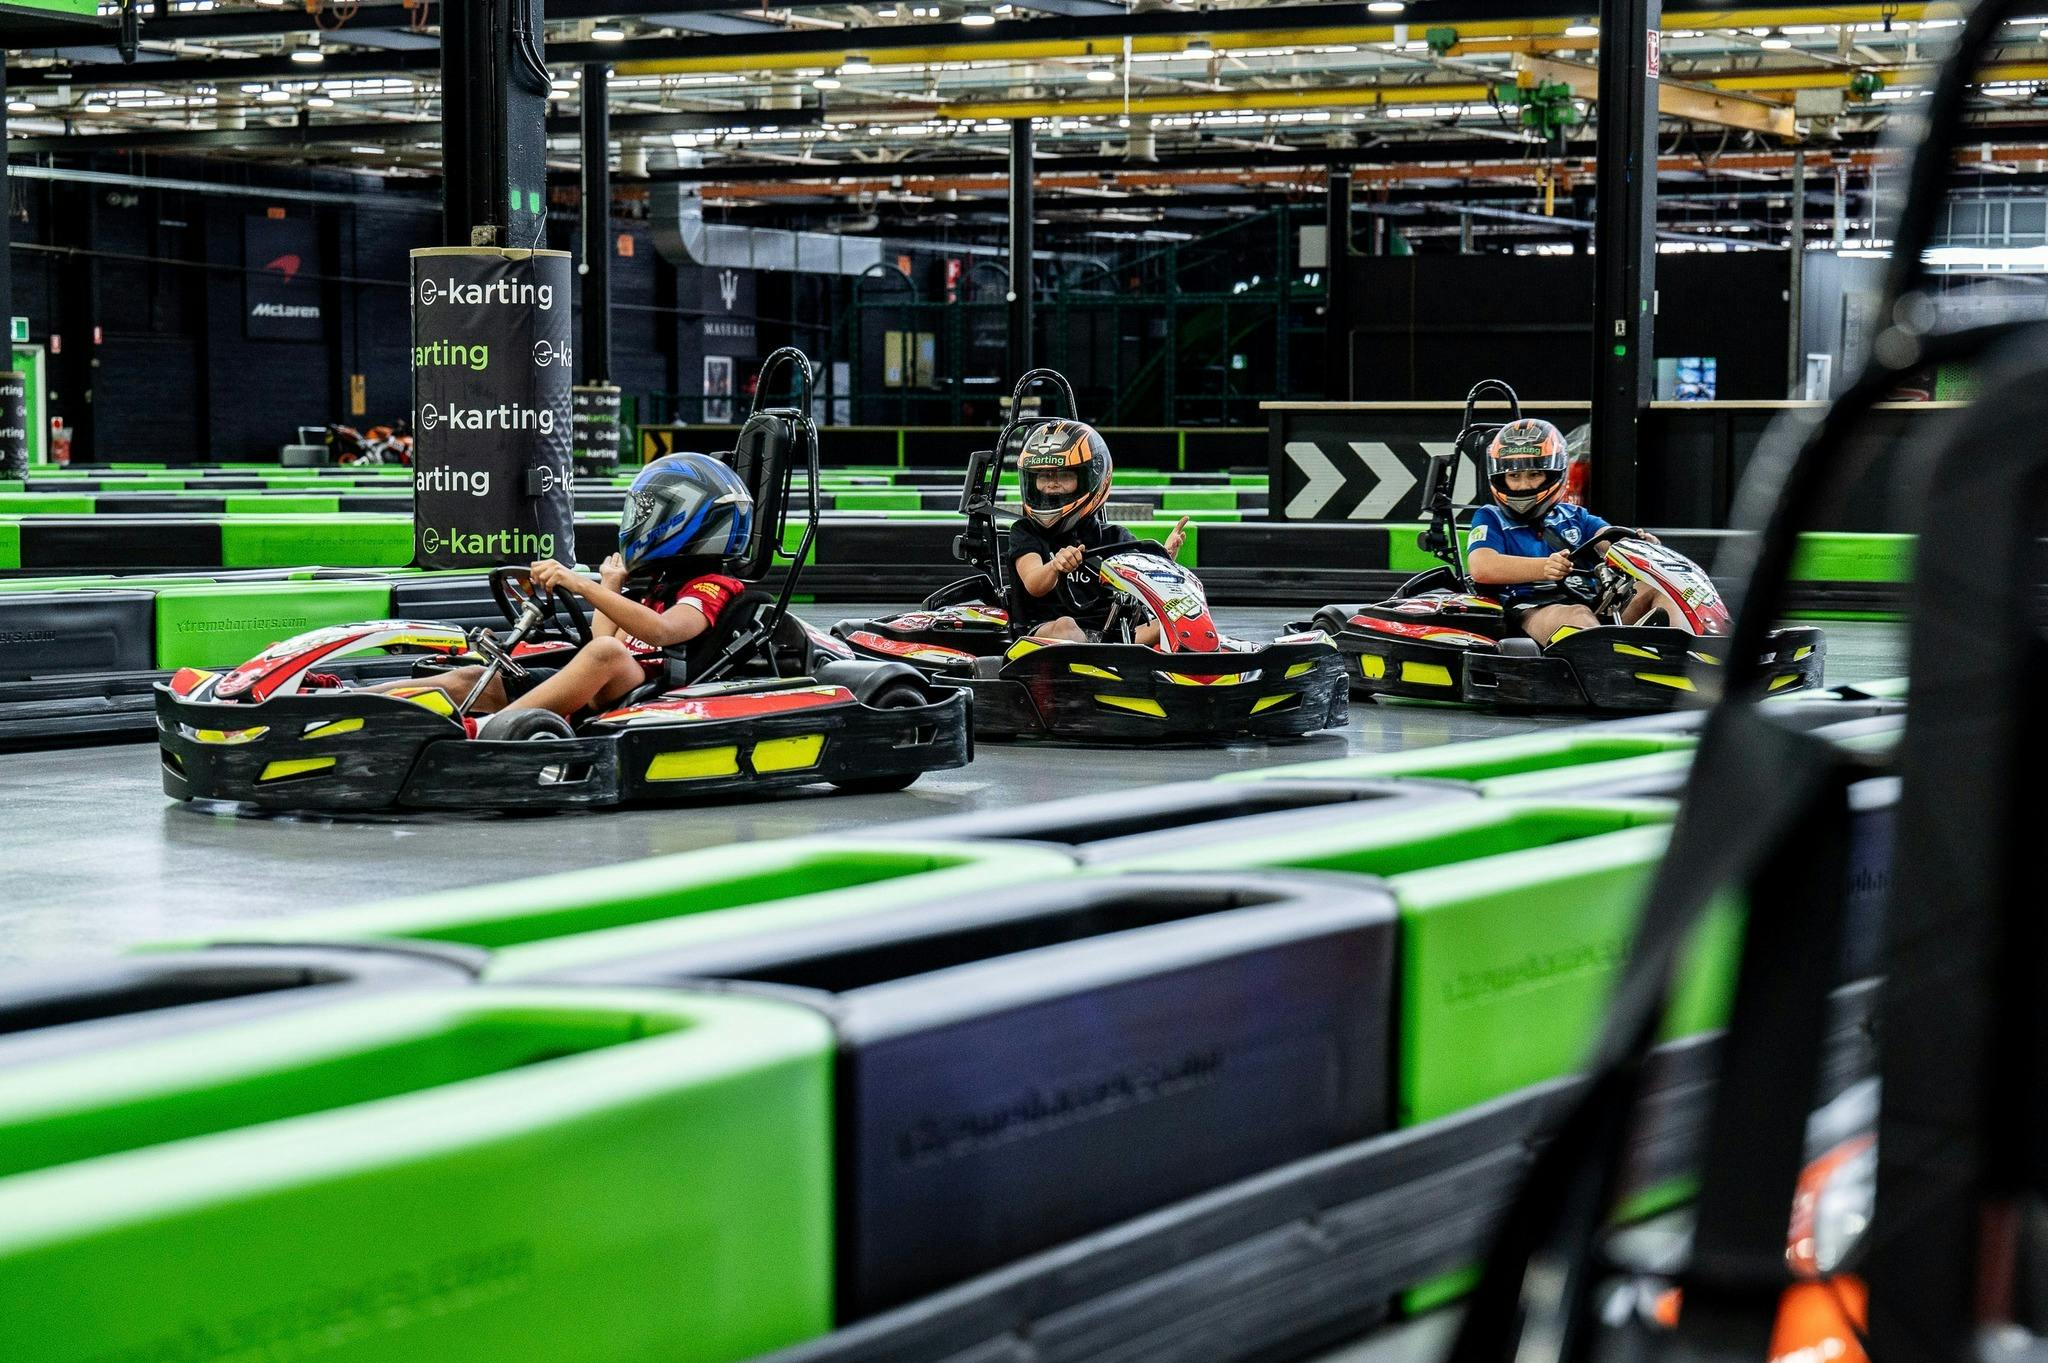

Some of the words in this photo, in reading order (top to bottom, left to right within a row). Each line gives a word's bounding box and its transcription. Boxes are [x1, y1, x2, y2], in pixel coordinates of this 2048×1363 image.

[420, 277, 553, 311] e-karting
[252, 303, 320, 318] McLaren
[421, 403, 554, 435] e-karting
[422, 527, 555, 559] e-karting
[176, 617, 307, 633] xtremebarriers.com
